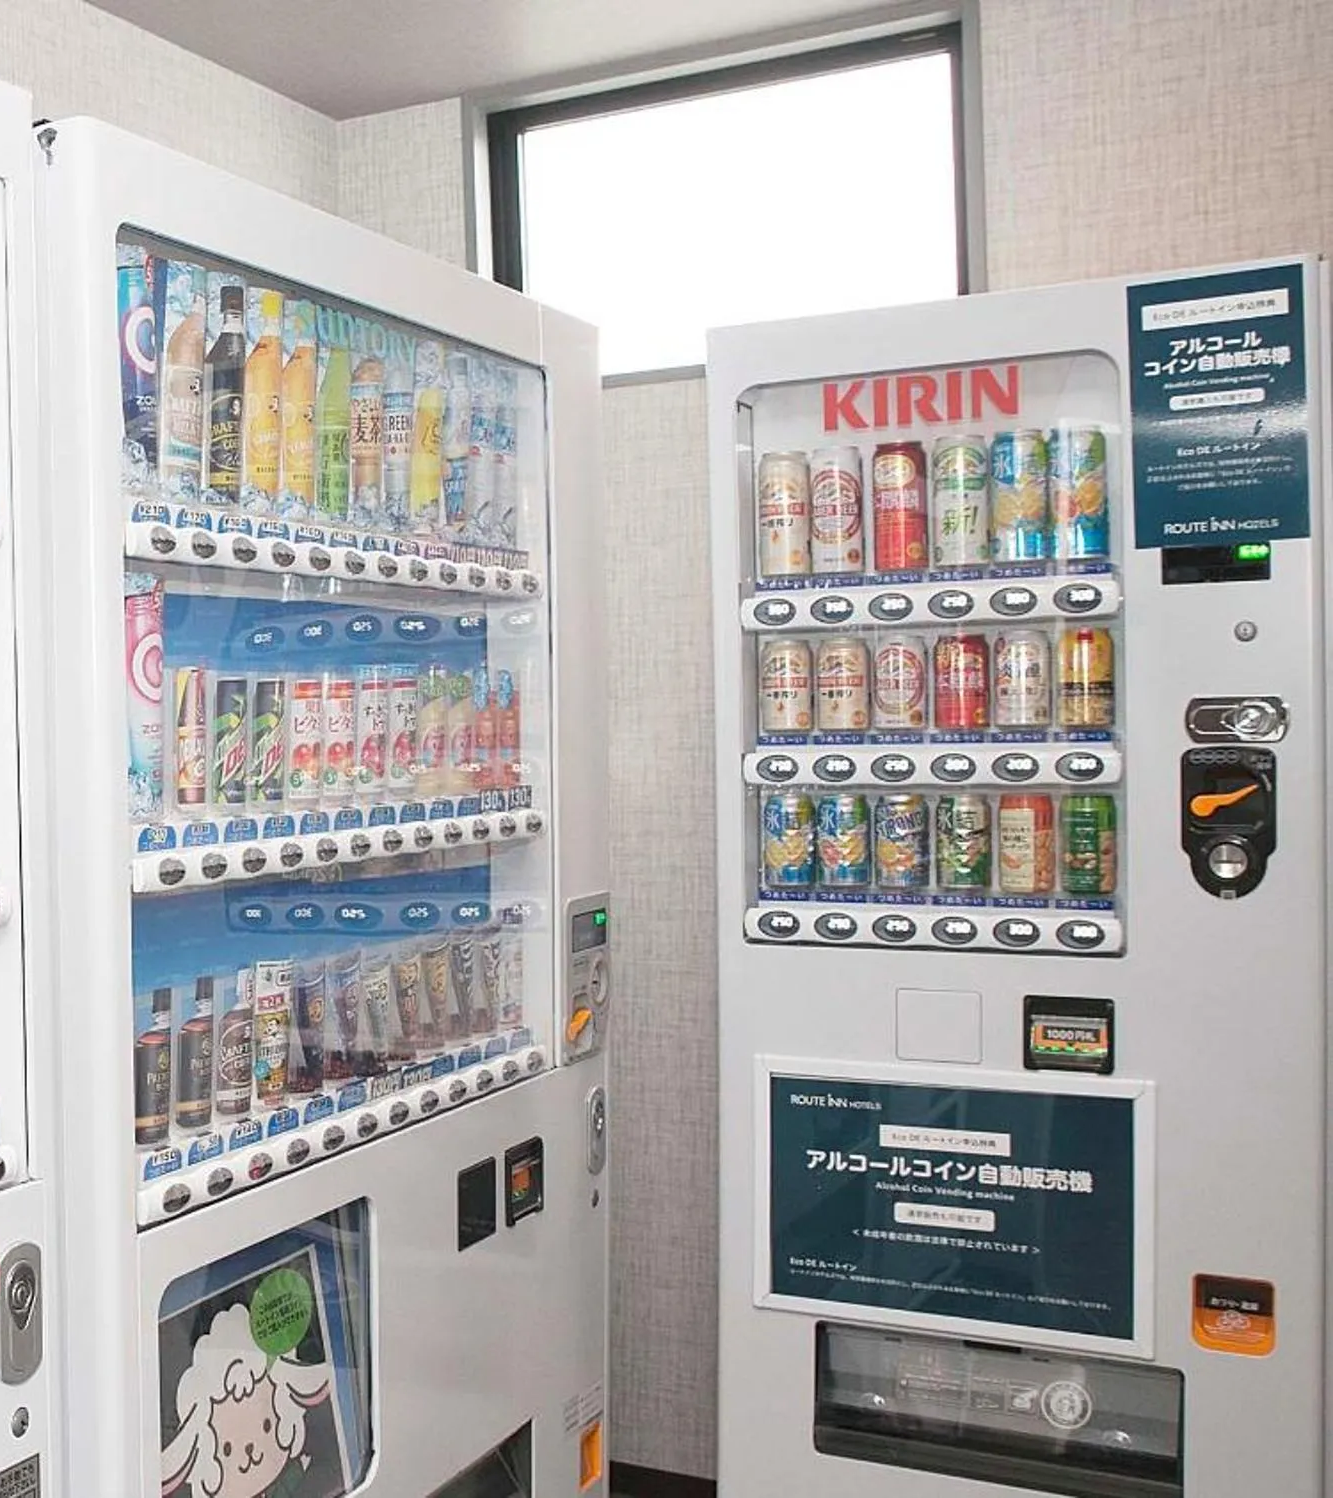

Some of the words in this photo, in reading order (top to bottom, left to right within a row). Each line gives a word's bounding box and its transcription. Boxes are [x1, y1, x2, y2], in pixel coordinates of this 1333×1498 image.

[1169, 331, 1262, 356] アルコール
[1144, 346, 1291, 376] コイン自動販売機
[823, 364, 1020, 431] KIRIN
[1163, 521, 1209, 535] ROUTE
[790, 1093, 826, 1107] ROUTE
[805, 1149, 1094, 1194] アルコールコイン自動販売機
